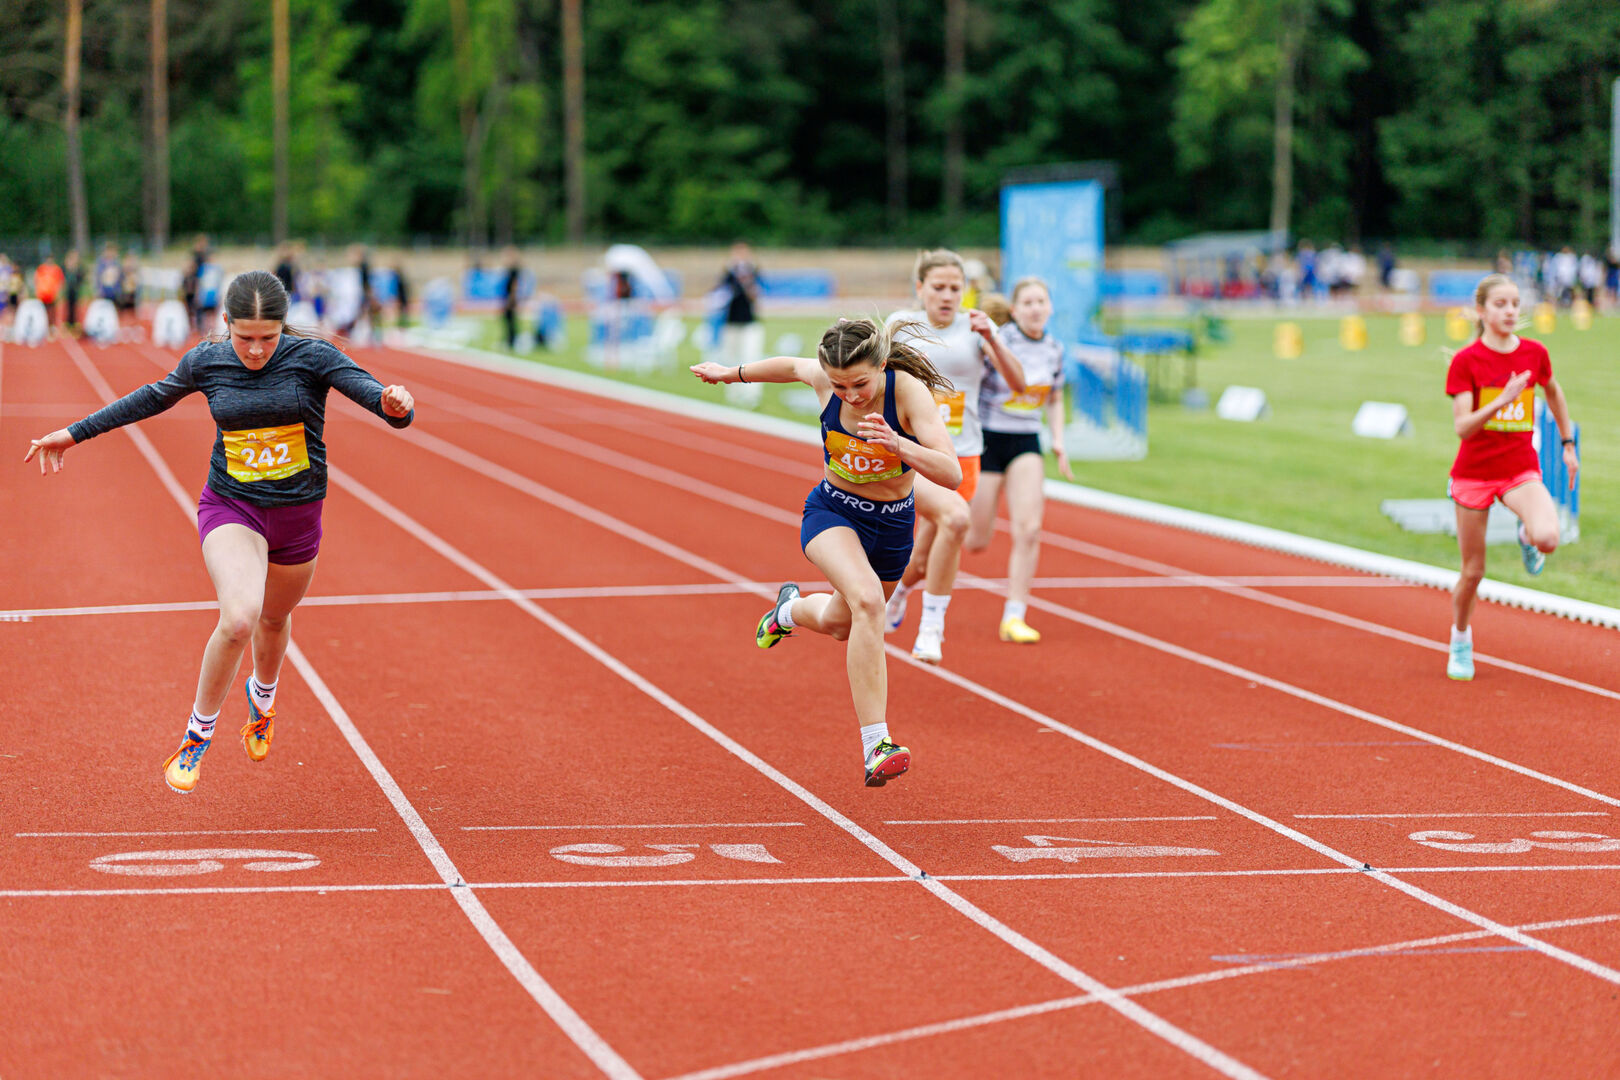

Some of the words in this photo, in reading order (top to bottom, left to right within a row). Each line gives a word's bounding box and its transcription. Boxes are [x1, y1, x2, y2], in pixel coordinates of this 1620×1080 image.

[241, 443, 292, 468] 242
[840, 453, 885, 472] 402
[831, 490, 875, 512] PRO
[990, 835, 1221, 863] 4
[1408, 830, 1620, 854] 3
[89, 849, 321, 876] 6
[549, 843, 785, 866] 5
